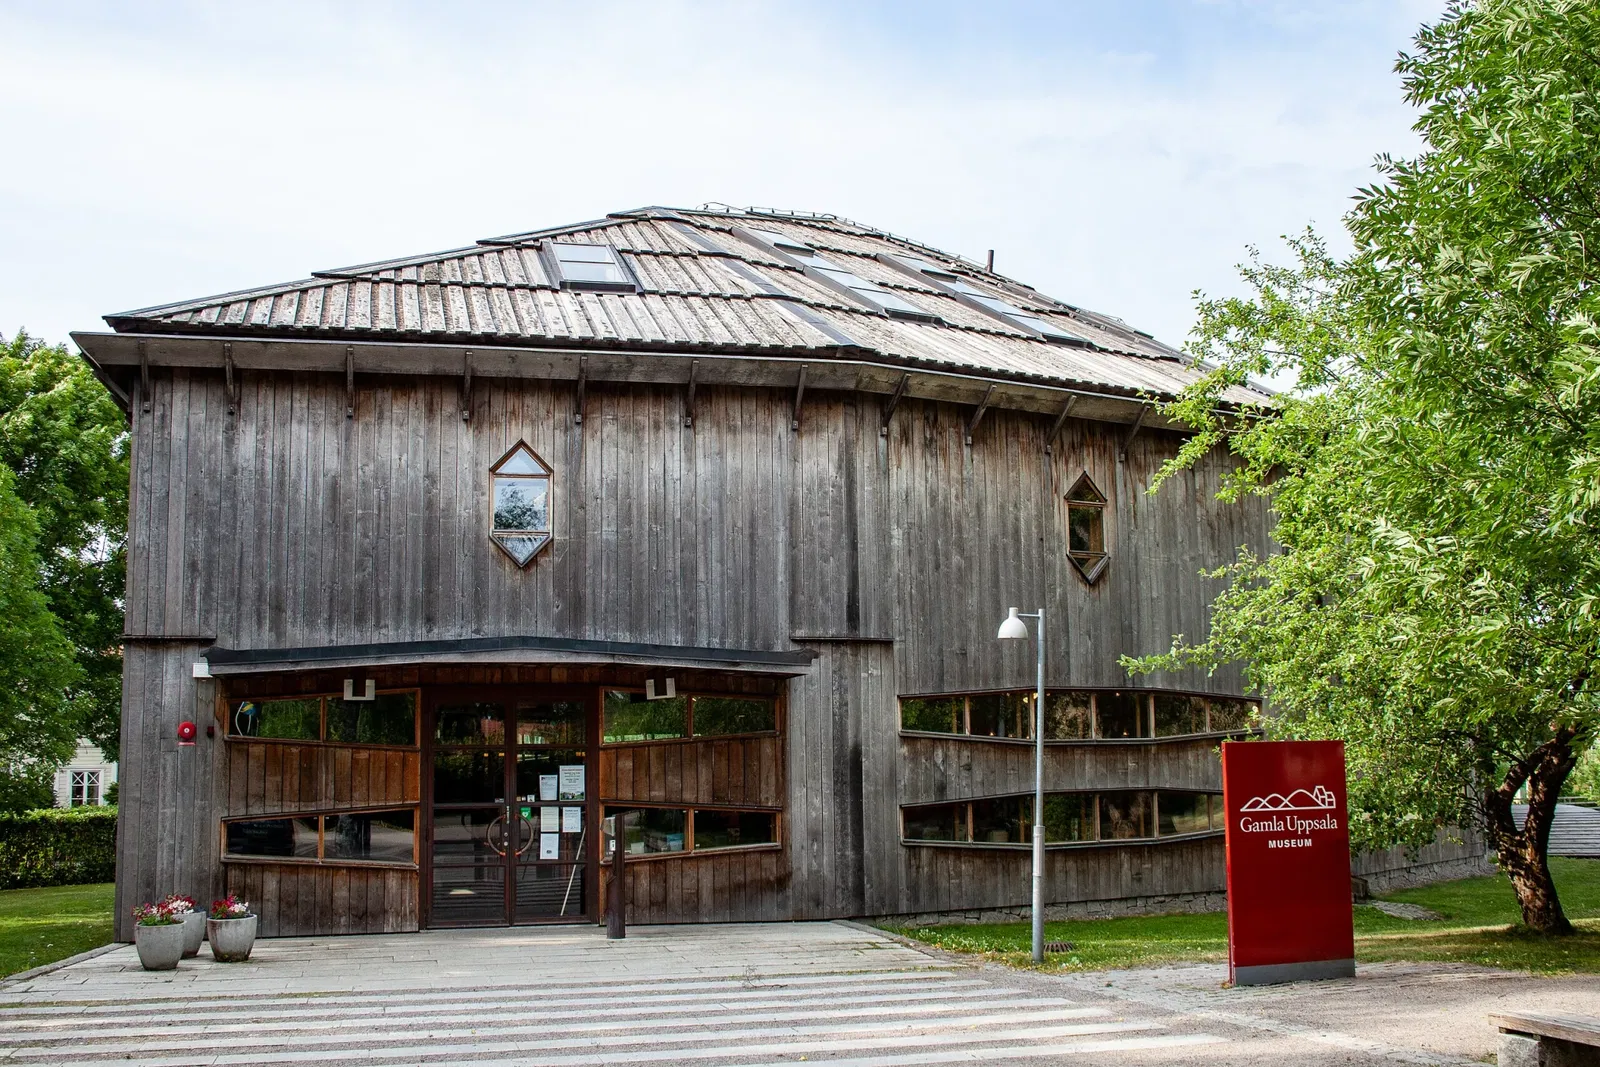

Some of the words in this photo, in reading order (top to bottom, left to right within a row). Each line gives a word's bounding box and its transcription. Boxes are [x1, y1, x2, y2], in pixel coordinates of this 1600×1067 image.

[1240, 815, 1284, 833] Gamla
[1286, 813, 1338, 834] Uppsala
[1268, 838, 1312, 849] MUSEUM
